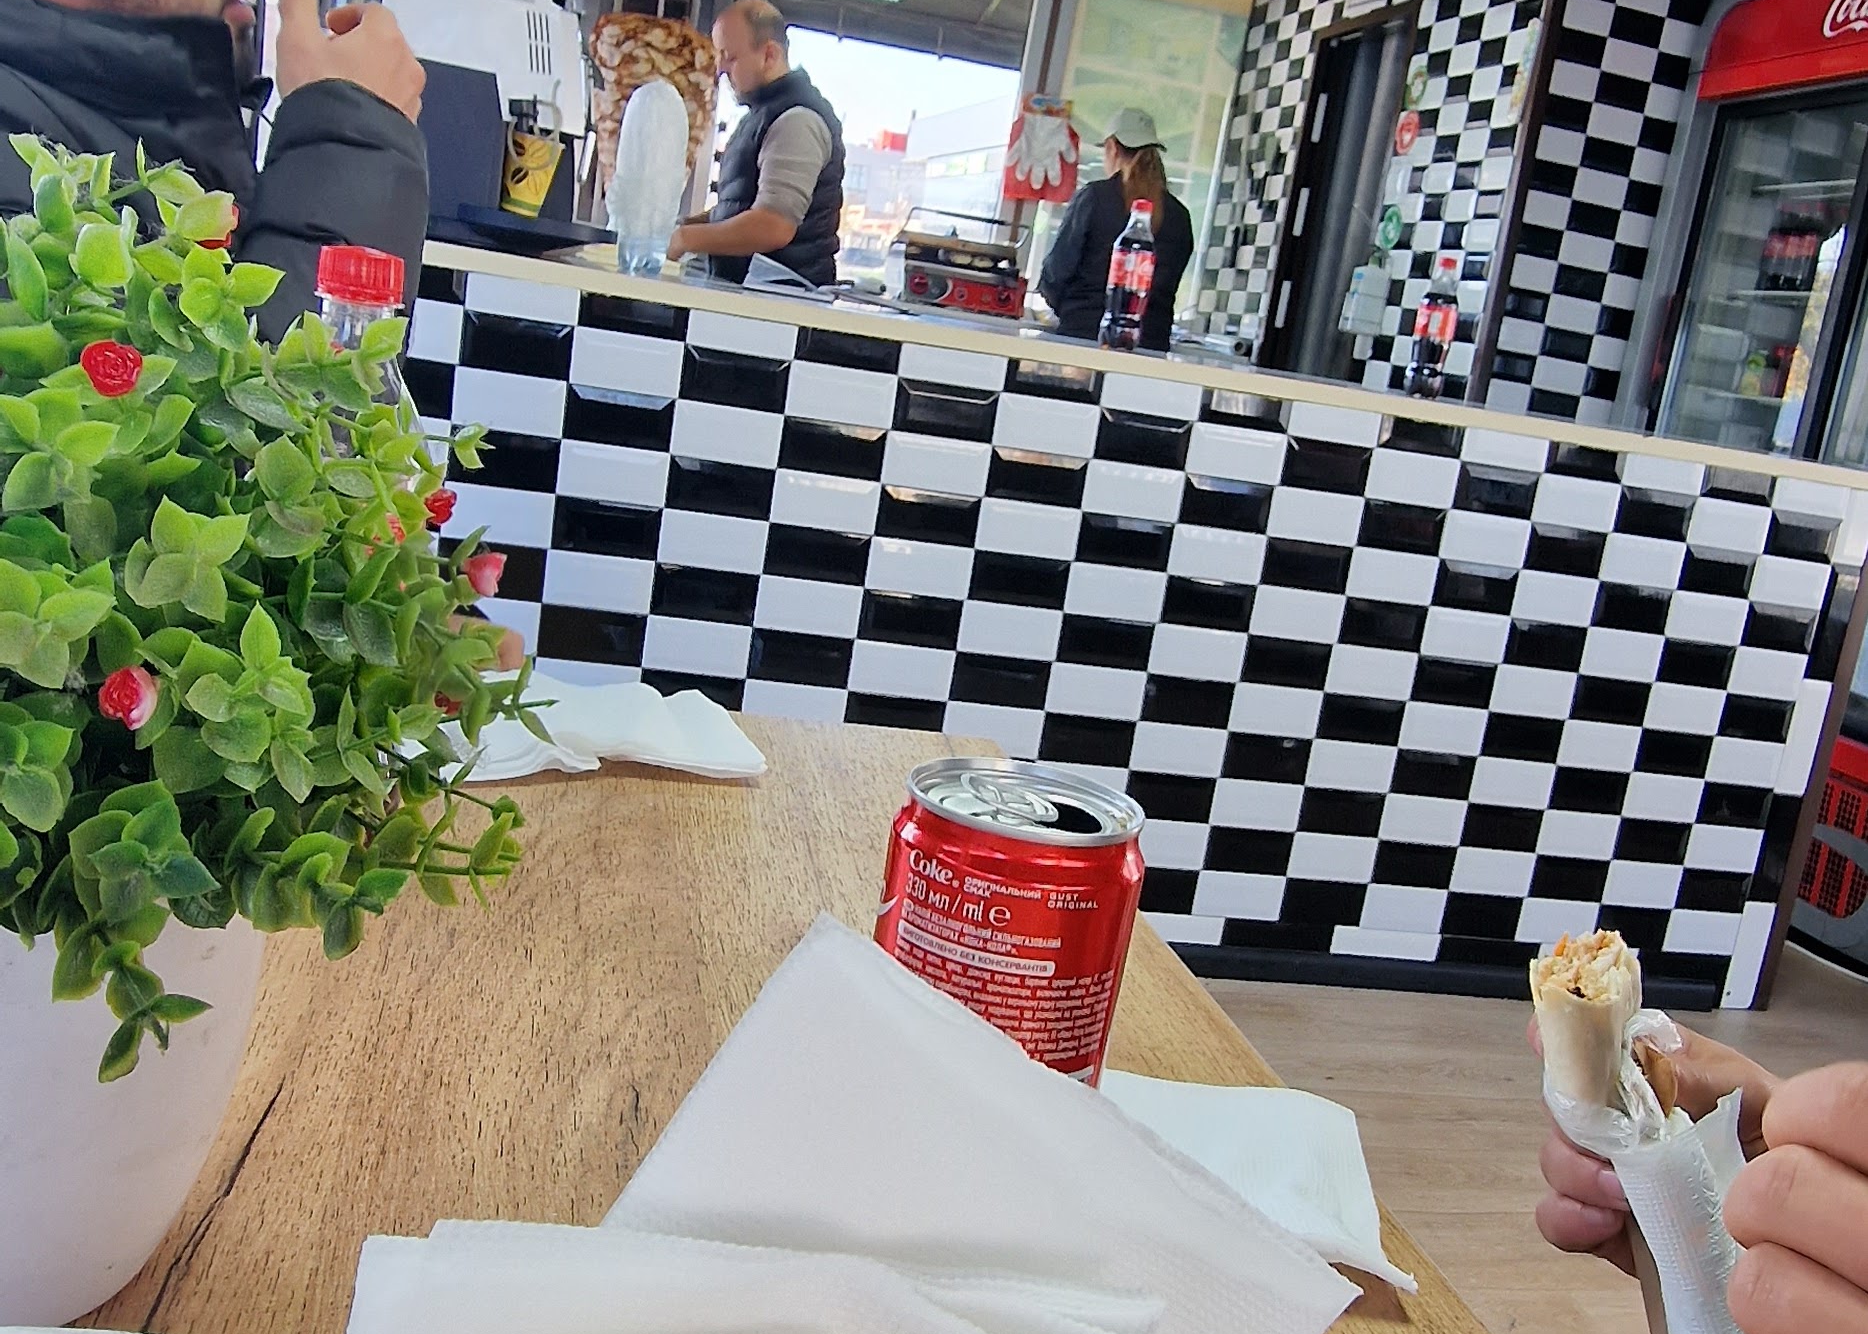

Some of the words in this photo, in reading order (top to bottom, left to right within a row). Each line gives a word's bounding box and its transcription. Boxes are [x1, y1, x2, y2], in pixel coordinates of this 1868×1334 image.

[906, 871, 926, 900] 330
[928, 890, 950, 913] мл
[951, 893, 962, 915] /
[962, 900, 984, 923] ml
[1048, 900, 1098, 910] ORIGINAL
